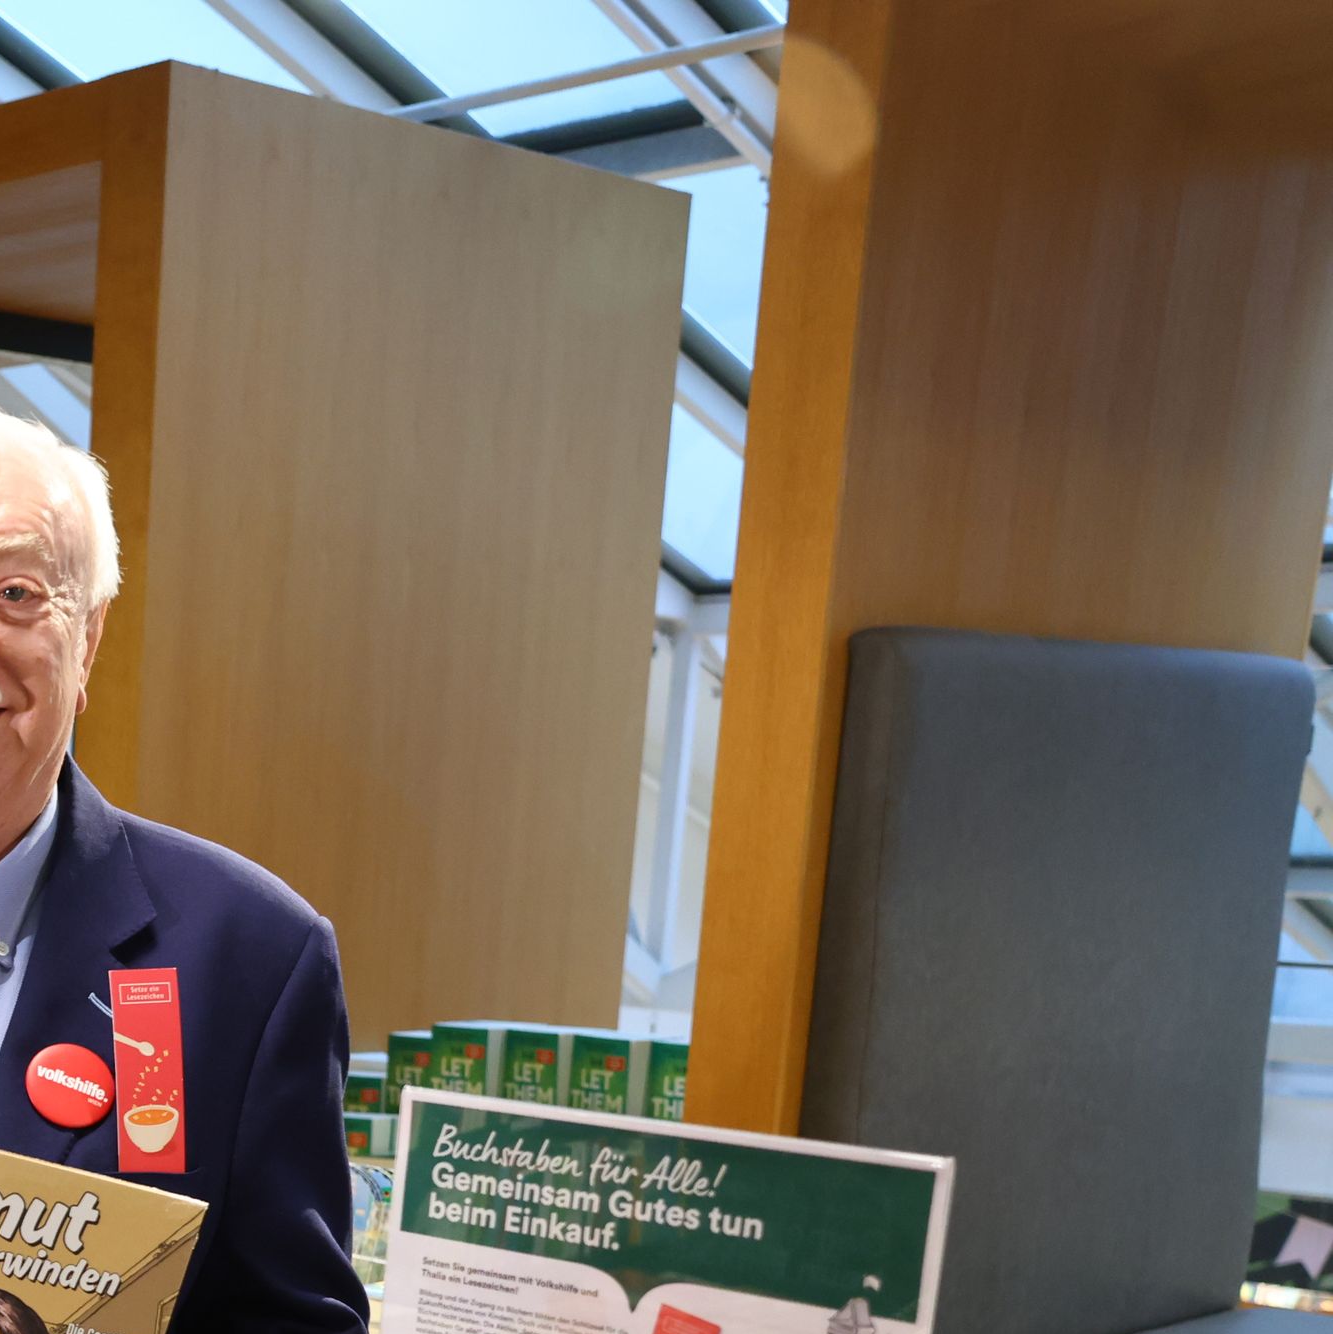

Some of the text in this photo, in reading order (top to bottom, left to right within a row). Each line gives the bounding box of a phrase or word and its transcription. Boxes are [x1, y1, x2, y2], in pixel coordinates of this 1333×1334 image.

[37, 1065, 108, 1103] volkshilfe.
[432, 1123, 727, 1198] Buchstaben für Alle!
[428, 1192, 620, 1251] beim Einkauf.
[432, 1161, 763, 1241] Gemeinsam Gutes tun
[421, 1268, 519, 1295] Thalia ein Lesezeichen!
[422, 1256, 599, 1298] Setzen Sie gemeinsam mit Volkshilfe und
